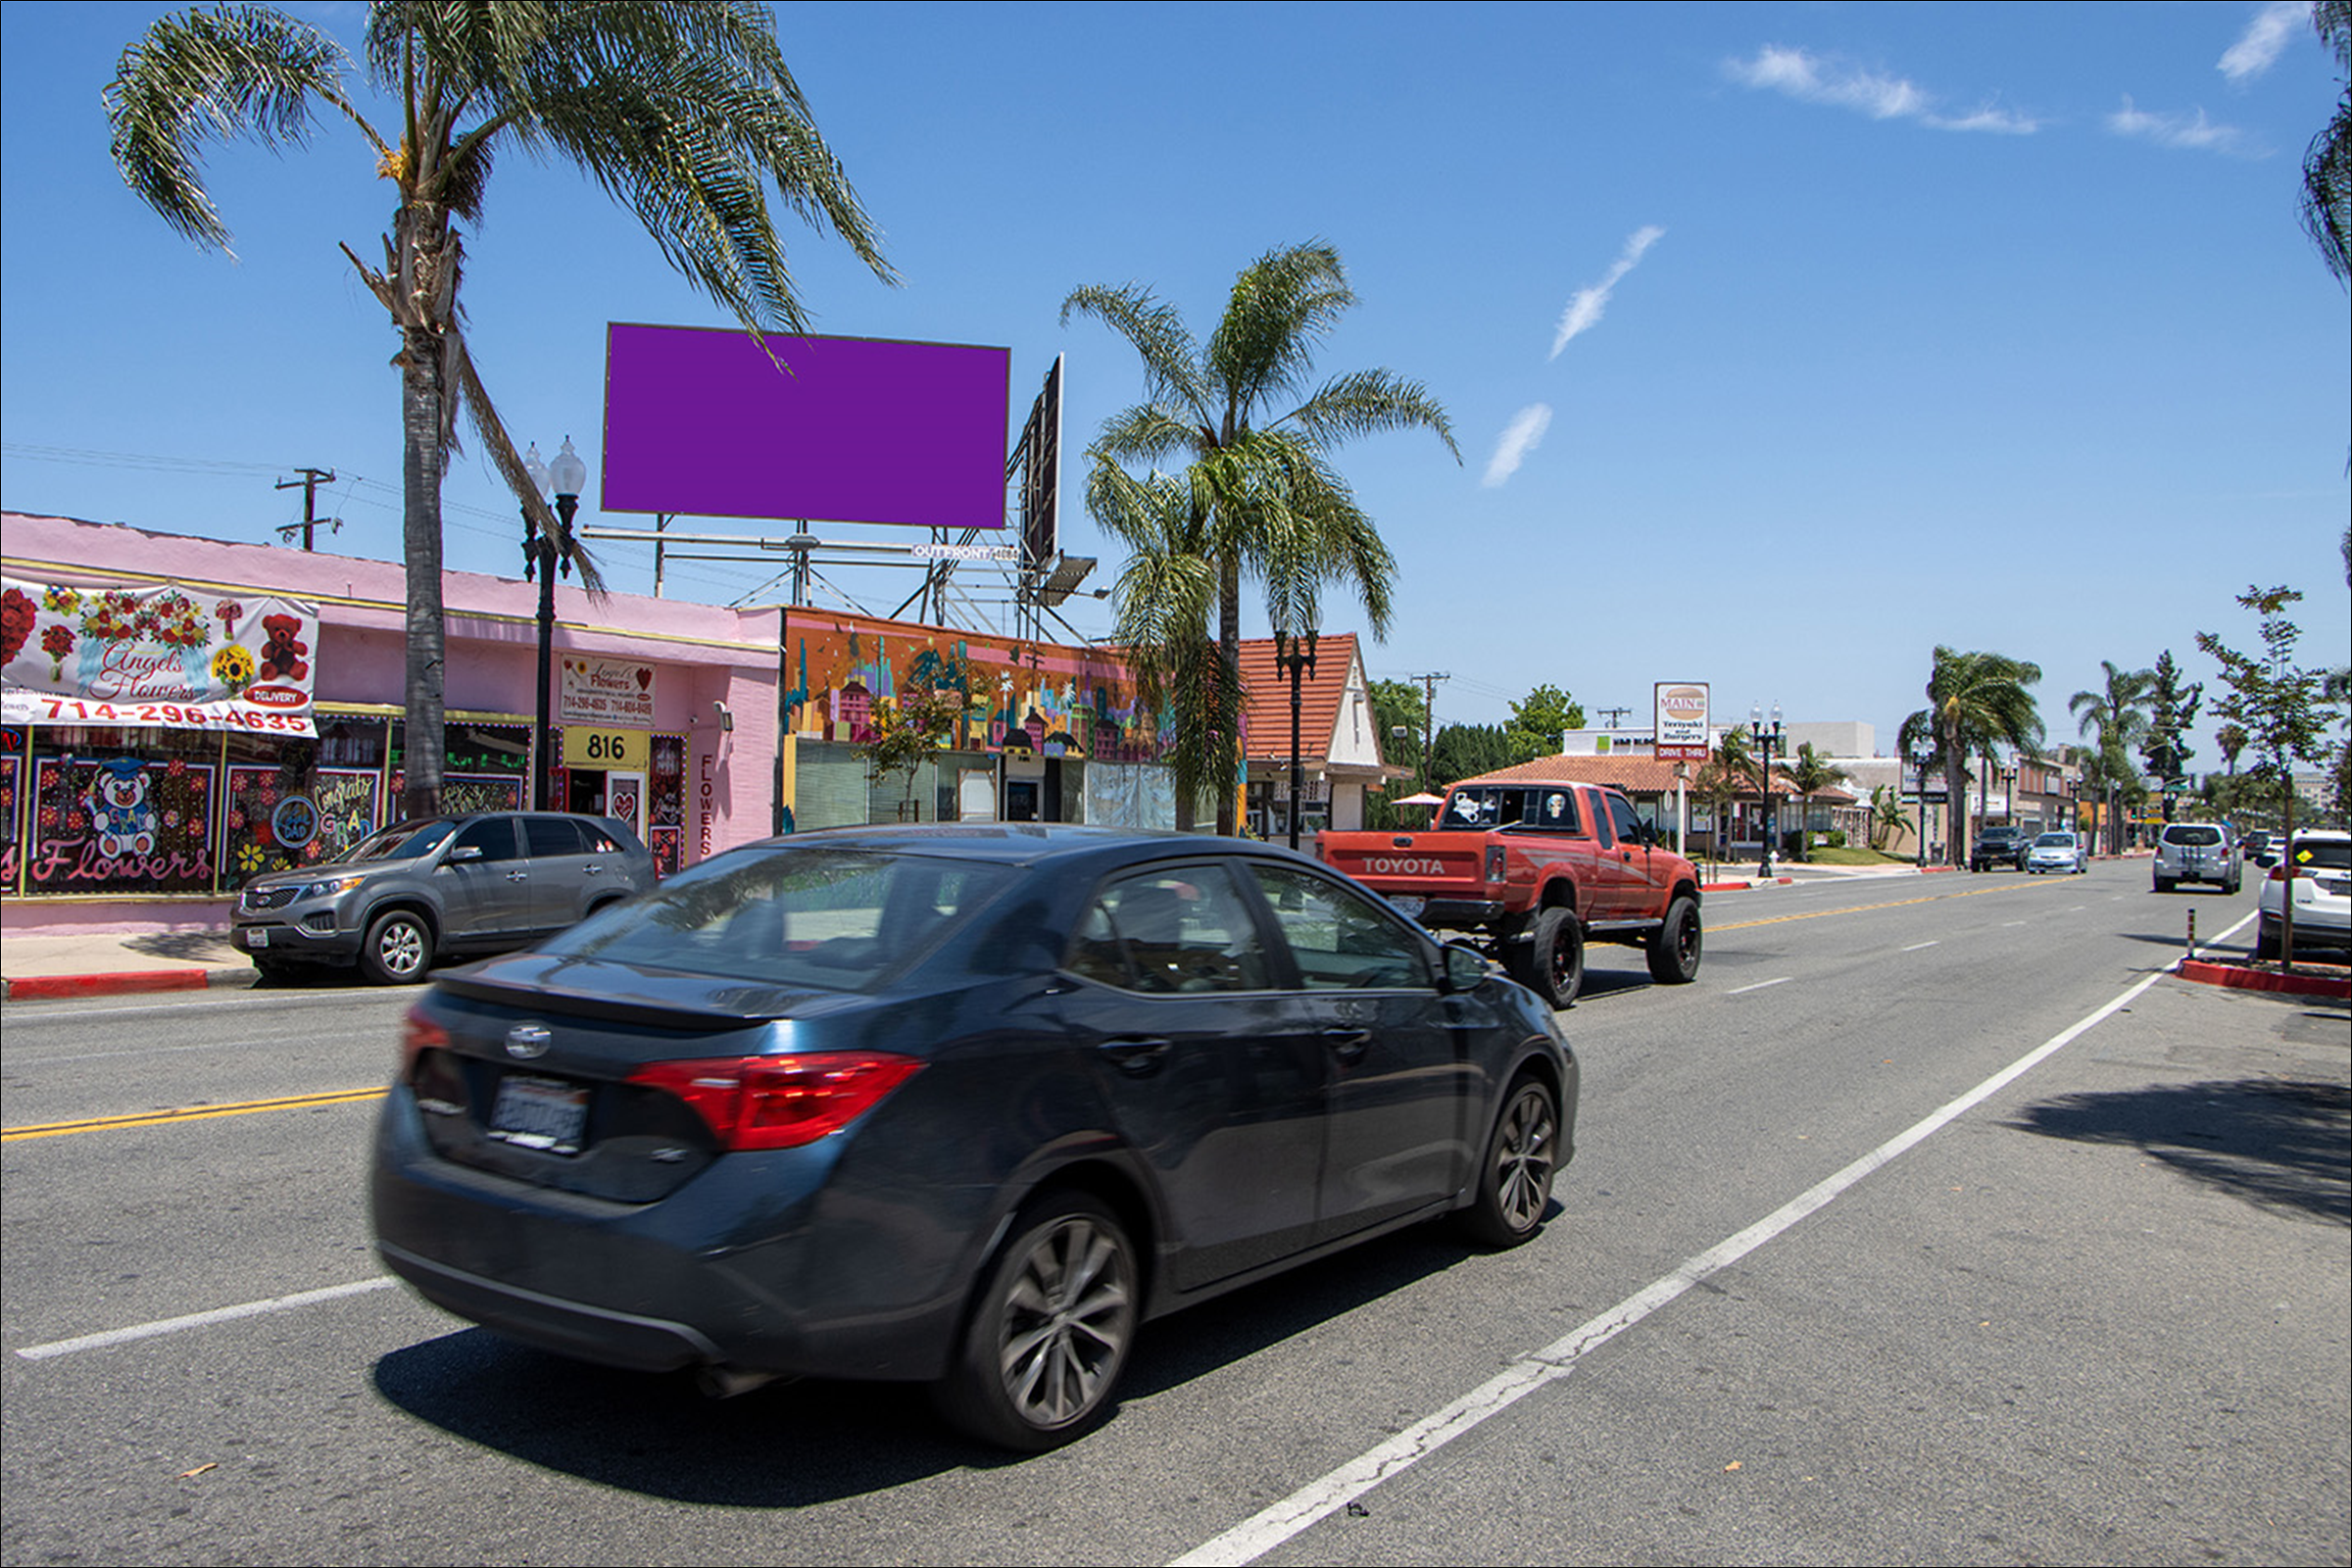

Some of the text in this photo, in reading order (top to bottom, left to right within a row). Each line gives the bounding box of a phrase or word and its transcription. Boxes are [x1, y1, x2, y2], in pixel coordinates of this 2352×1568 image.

[100, 641, 186, 673] Angels
[88, 668, 197, 701] Flowers
[253, 689, 298, 704] DELIVERY
[40, 699, 307, 732] 714-296-4635
[1661, 698, 1695, 709] MAIN
[587, 734, 624, 760] 816
[1659, 748, 1706, 758] DRIVE THRU
[700, 754, 713, 856] FLOWERS
[319, 809, 372, 845] GRAD
[30, 835, 214, 881] Flowers
[1362, 858, 1445, 874] TOYOTA
